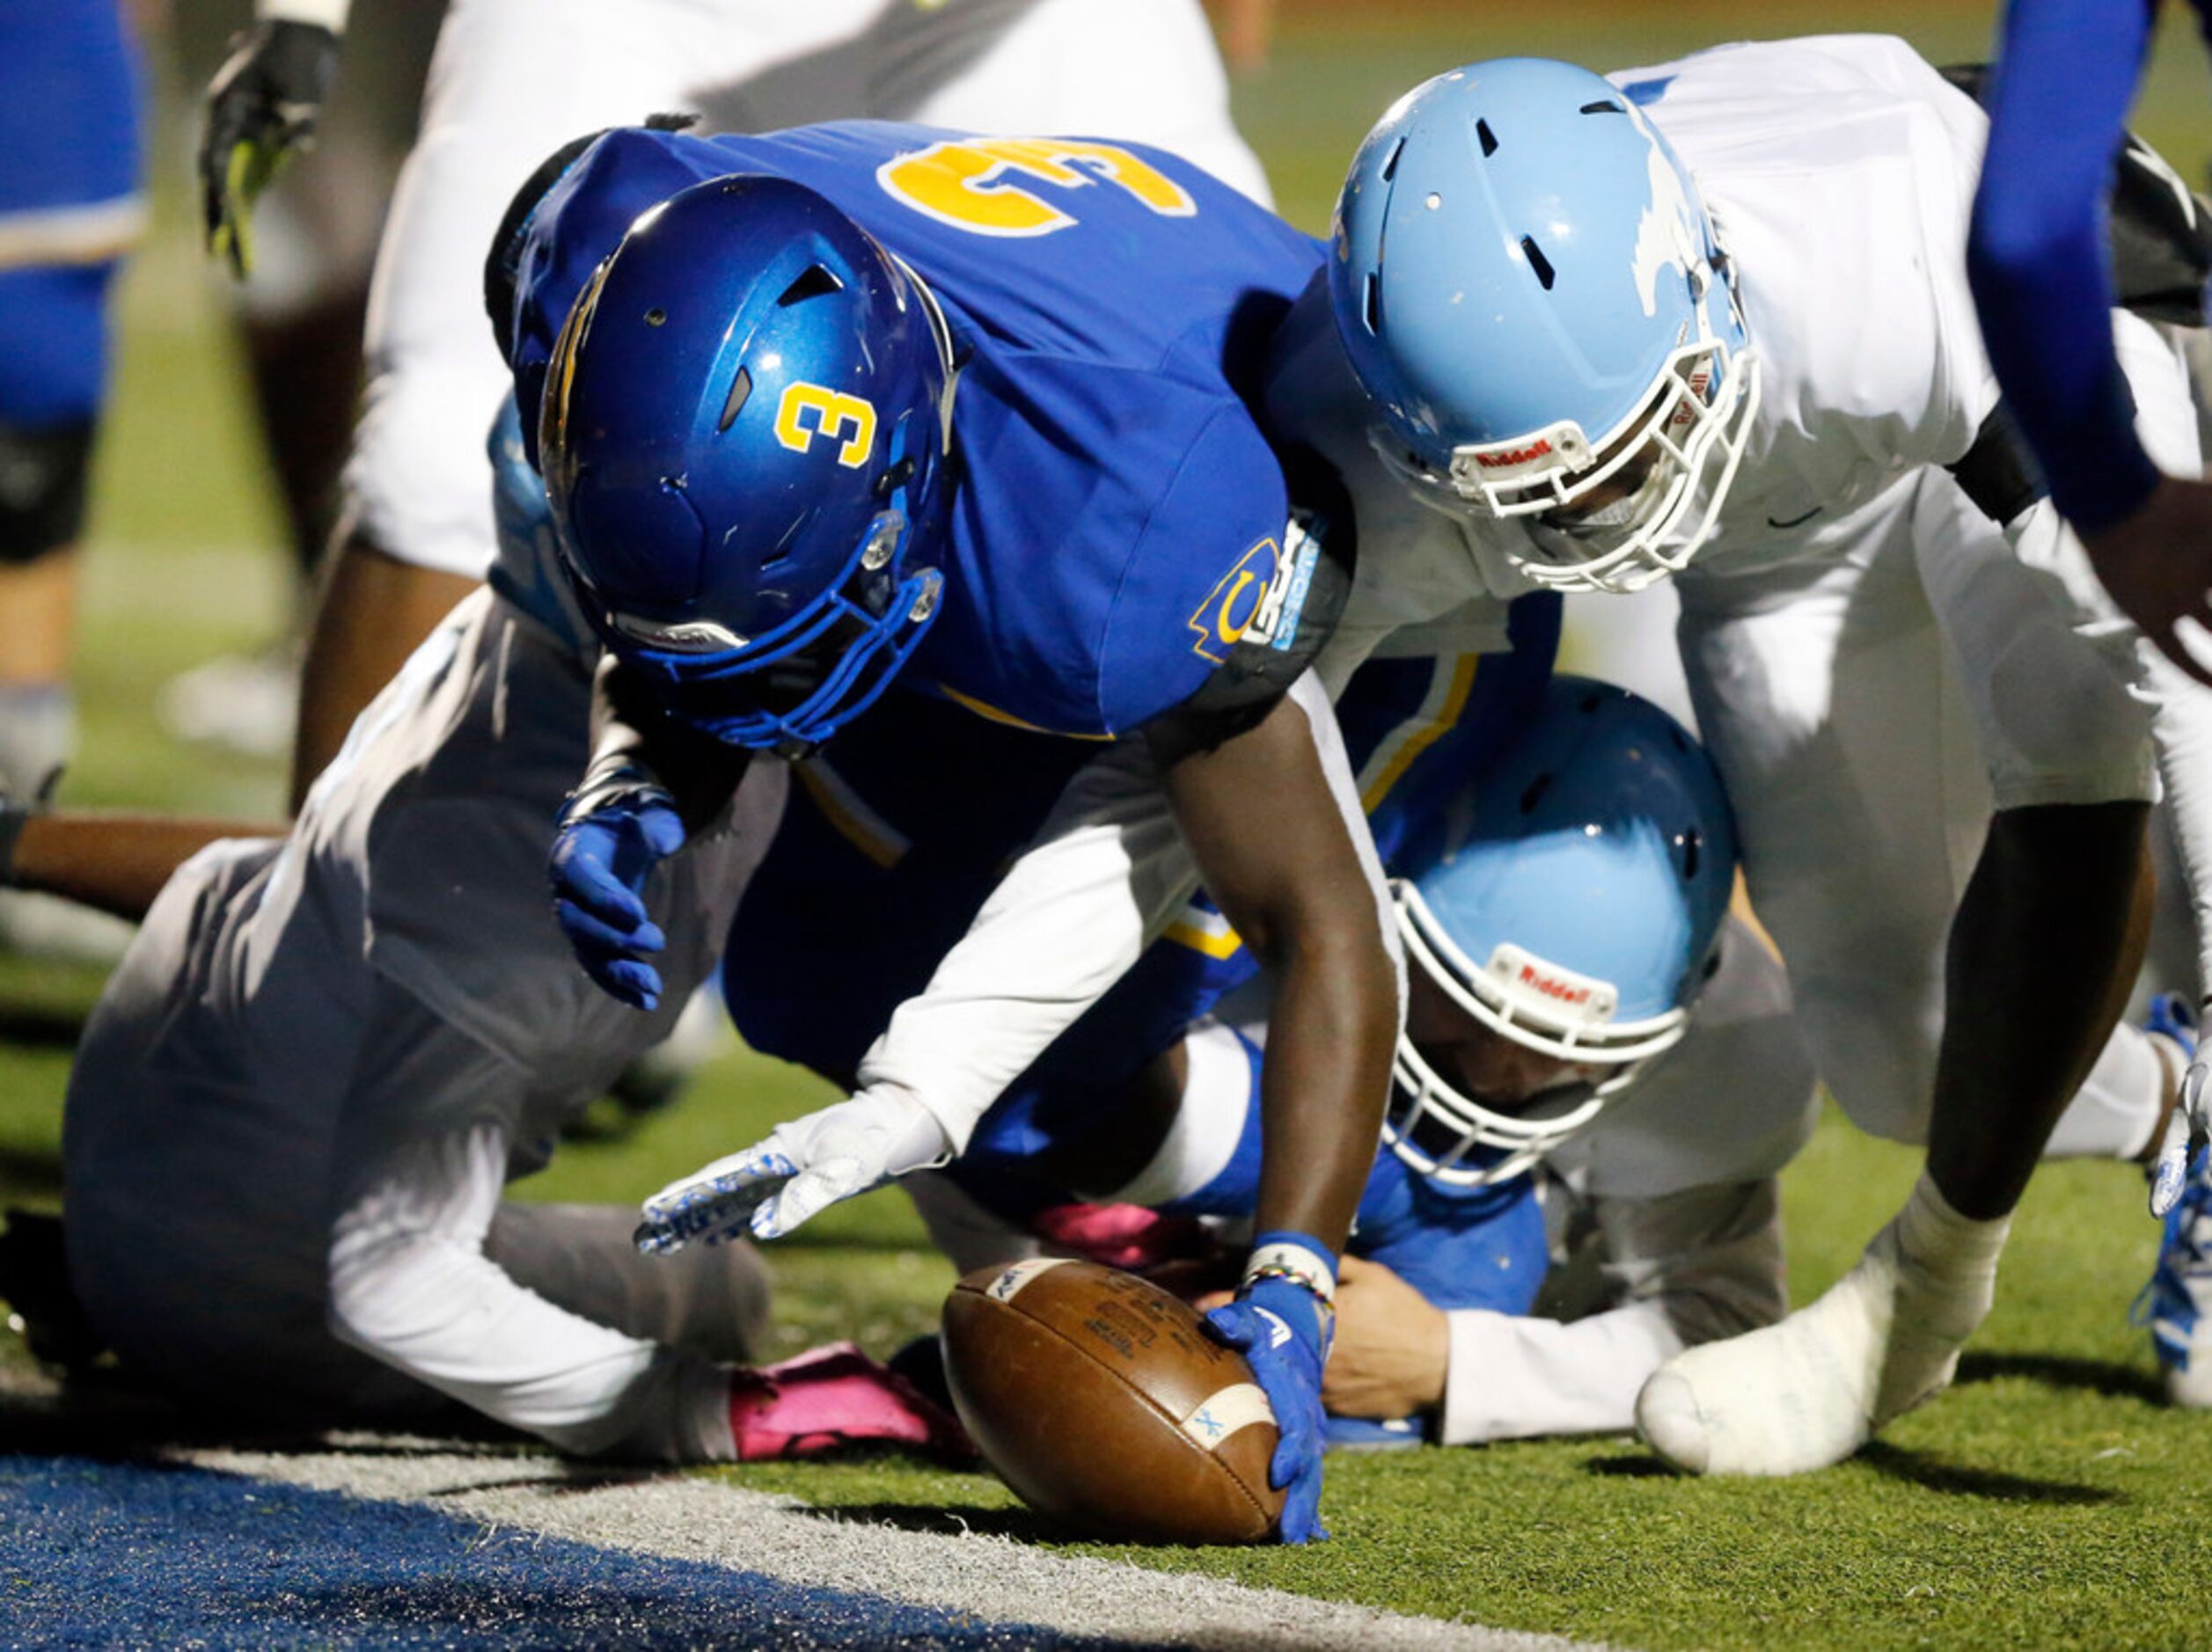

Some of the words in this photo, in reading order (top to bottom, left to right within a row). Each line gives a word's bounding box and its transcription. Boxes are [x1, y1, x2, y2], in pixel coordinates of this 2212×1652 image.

[876, 136, 1198, 238] 3
[773, 380, 878, 470] 3
[1519, 965, 1590, 1005] Riddell
